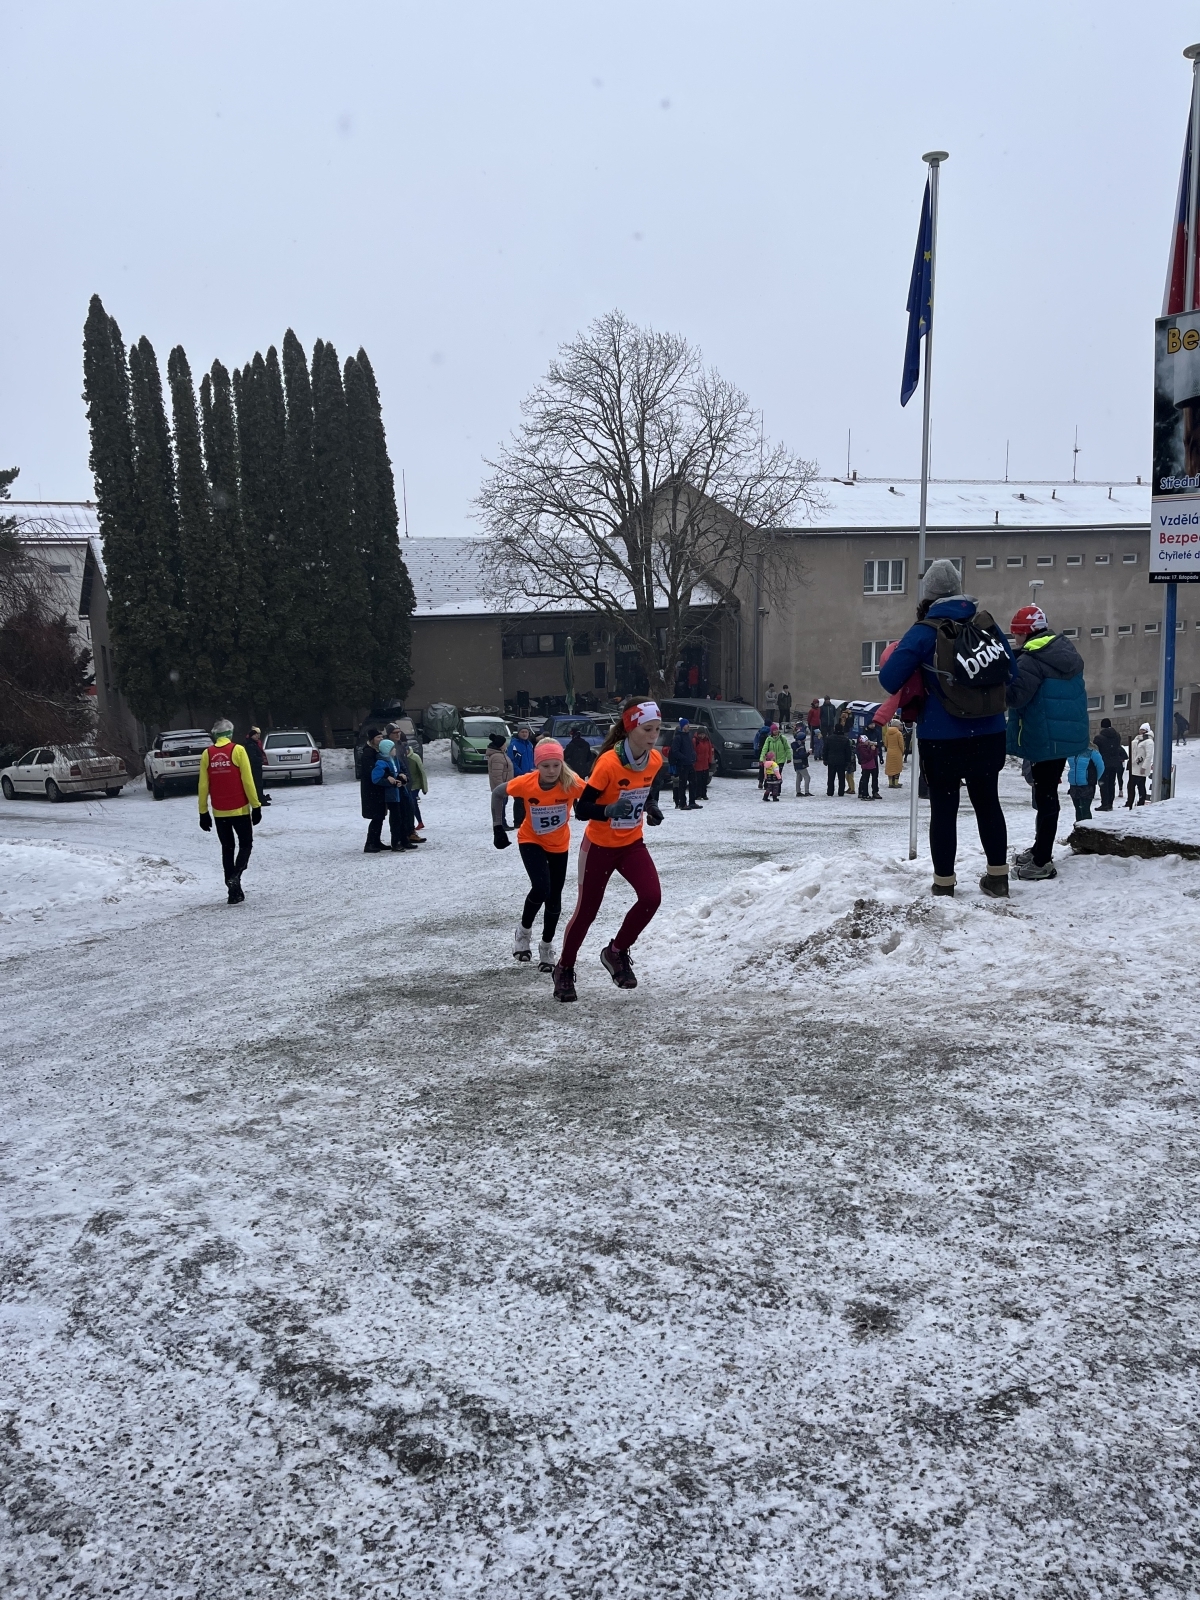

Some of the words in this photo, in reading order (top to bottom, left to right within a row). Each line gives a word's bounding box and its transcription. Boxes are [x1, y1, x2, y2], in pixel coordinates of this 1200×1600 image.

[1167, 327, 1200, 354] Be
[1160, 473, 1200, 489] Střední
[1160, 513, 1200, 526] Vzdělá
[1160, 532, 1200, 546] Bezpe
[540, 815, 560, 828] 58
